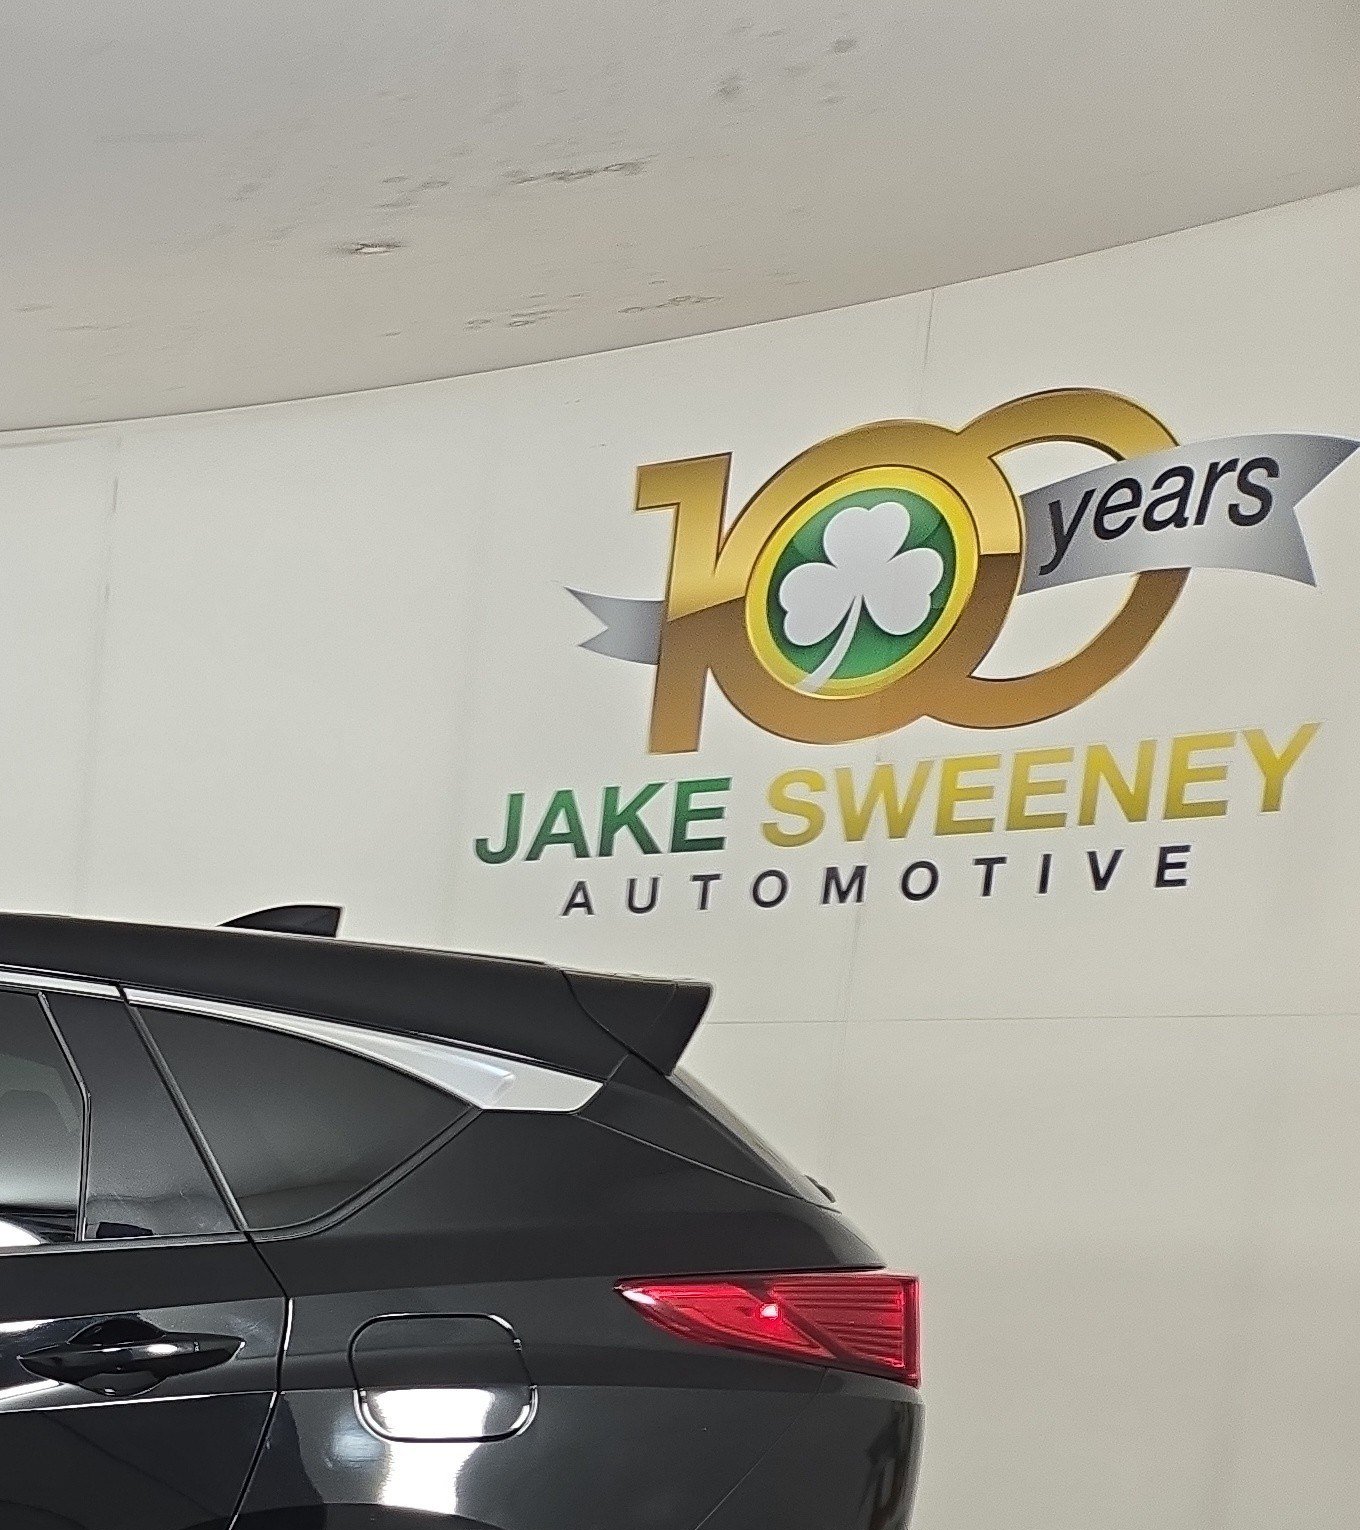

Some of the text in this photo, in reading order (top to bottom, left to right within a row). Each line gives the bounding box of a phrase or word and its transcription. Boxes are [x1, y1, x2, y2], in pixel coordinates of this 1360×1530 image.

[635, 387, 1280, 755] 100 years
[475, 723, 1320, 865] JAKE SWEENEY
[561, 844, 1193, 917] AUTOMOTIVE
